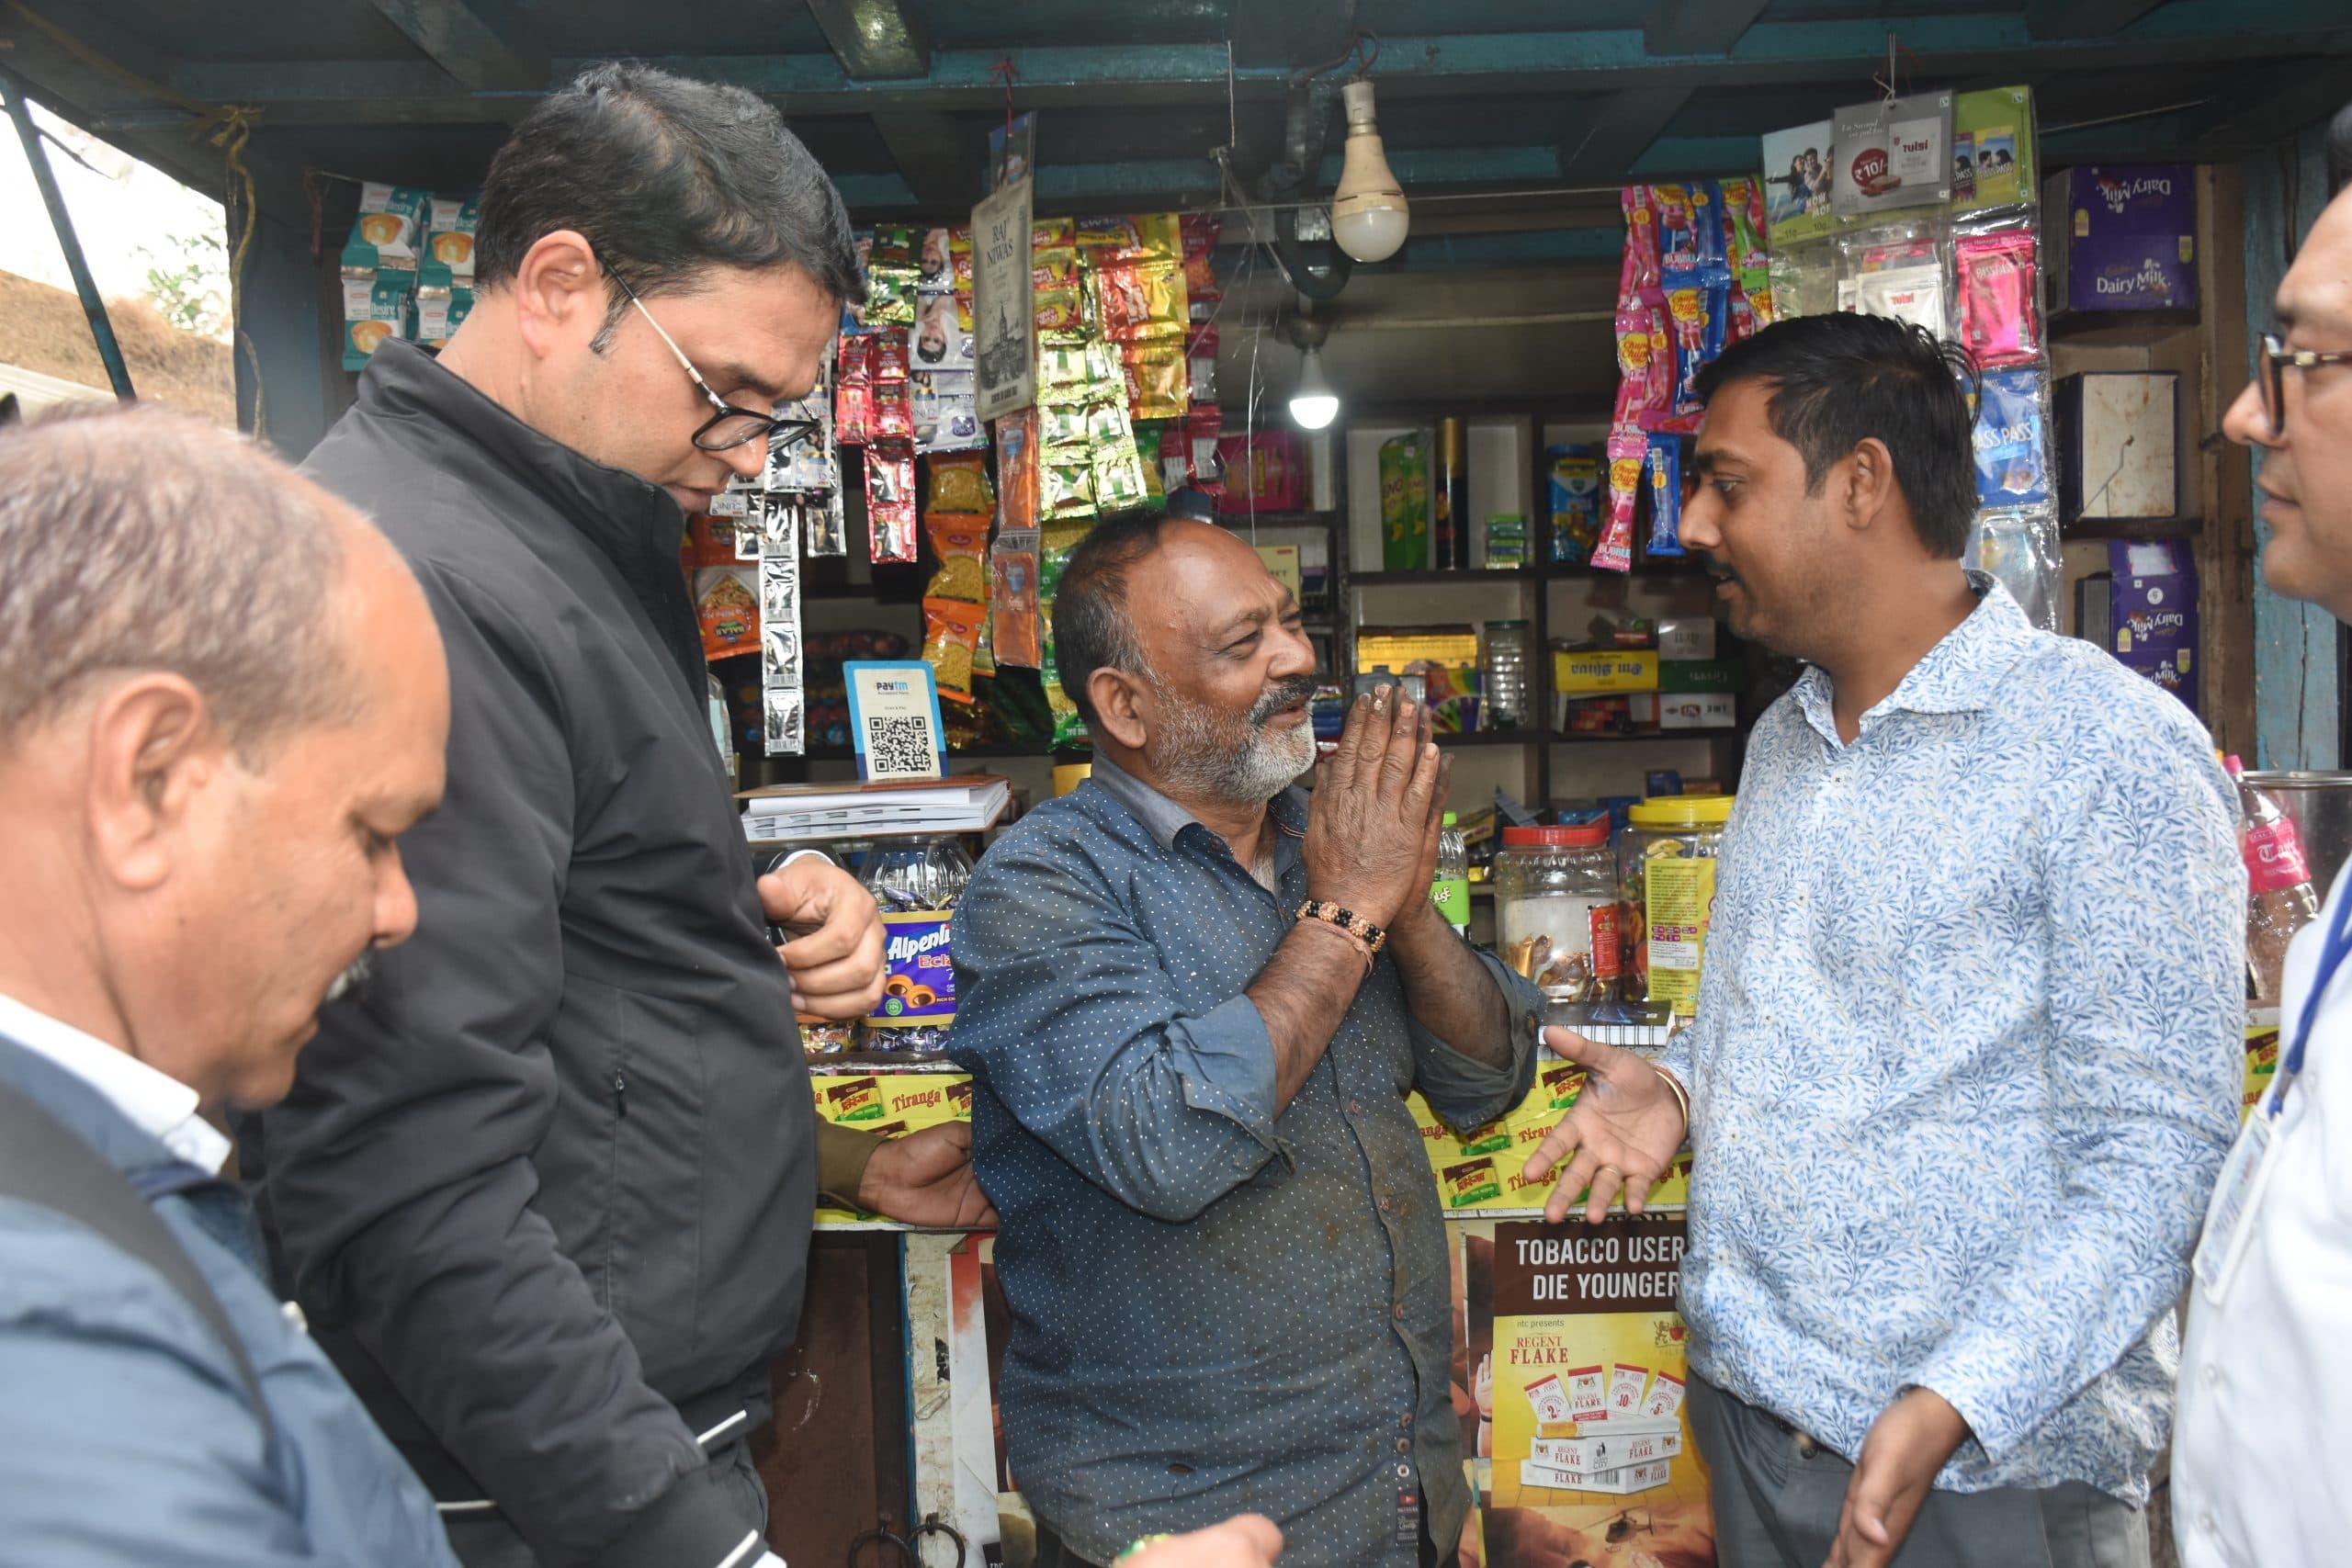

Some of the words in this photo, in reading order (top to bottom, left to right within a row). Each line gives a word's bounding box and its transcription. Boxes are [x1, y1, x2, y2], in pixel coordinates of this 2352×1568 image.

[2132, 178, 2171, 196] Dairy
[2097, 276, 2134, 294] Dairy
[1673, 302, 1698, 316] Chup
[1622, 348, 1647, 362] Chup
[2001, 422, 2033, 446] PASS
[1613, 472, 1636, 486] Chup
[2154, 613, 2183, 626] Dairy
[876, 682, 908, 691] paytm
[1429, 886, 1452, 905] ULSE
[888, 923, 951, 964] Alpenli
[919, 953, 951, 969] Ecla
[891, 1089, 942, 1113] Tiranga
[1519, 1124, 1554, 1144] Tiran
[1516, 1237, 1620, 1265] TOBACCO
[1628, 1235, 1685, 1264] USER
[1532, 1273, 1569, 1301] DIE
[1577, 1271, 1680, 1300] YOUNGER
[1517, 1320, 1529, 1328] ntc
[1531, 1319, 1565, 1329] presents
[1517, 1337, 1563, 1348] REGENT
[1510, 1348, 1568, 1365] FLAKE
[1575, 1399, 1600, 1409] FLAKE
[1555, 1452, 1581, 1465] FLAKE
[1629, 1446, 1653, 1459] FLAKE
[1555, 1472, 1582, 1484] FLAKE
